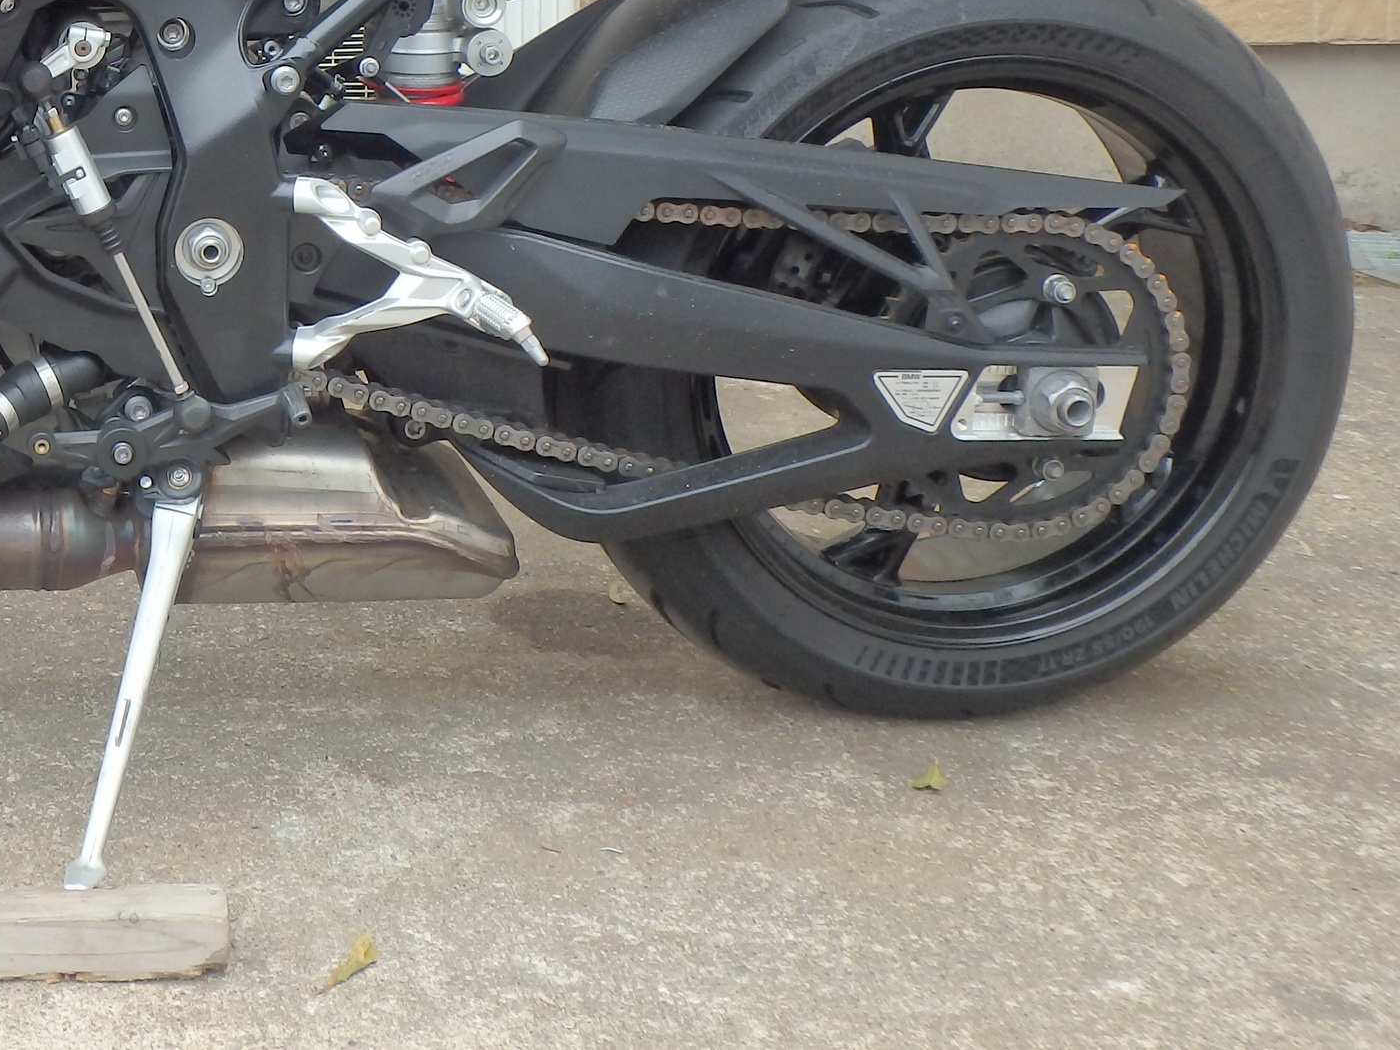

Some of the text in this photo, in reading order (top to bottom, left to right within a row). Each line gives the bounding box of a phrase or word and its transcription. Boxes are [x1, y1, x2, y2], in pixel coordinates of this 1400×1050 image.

[1038, 499, 1270, 673] MICHELIN 190/55 ZR 17
